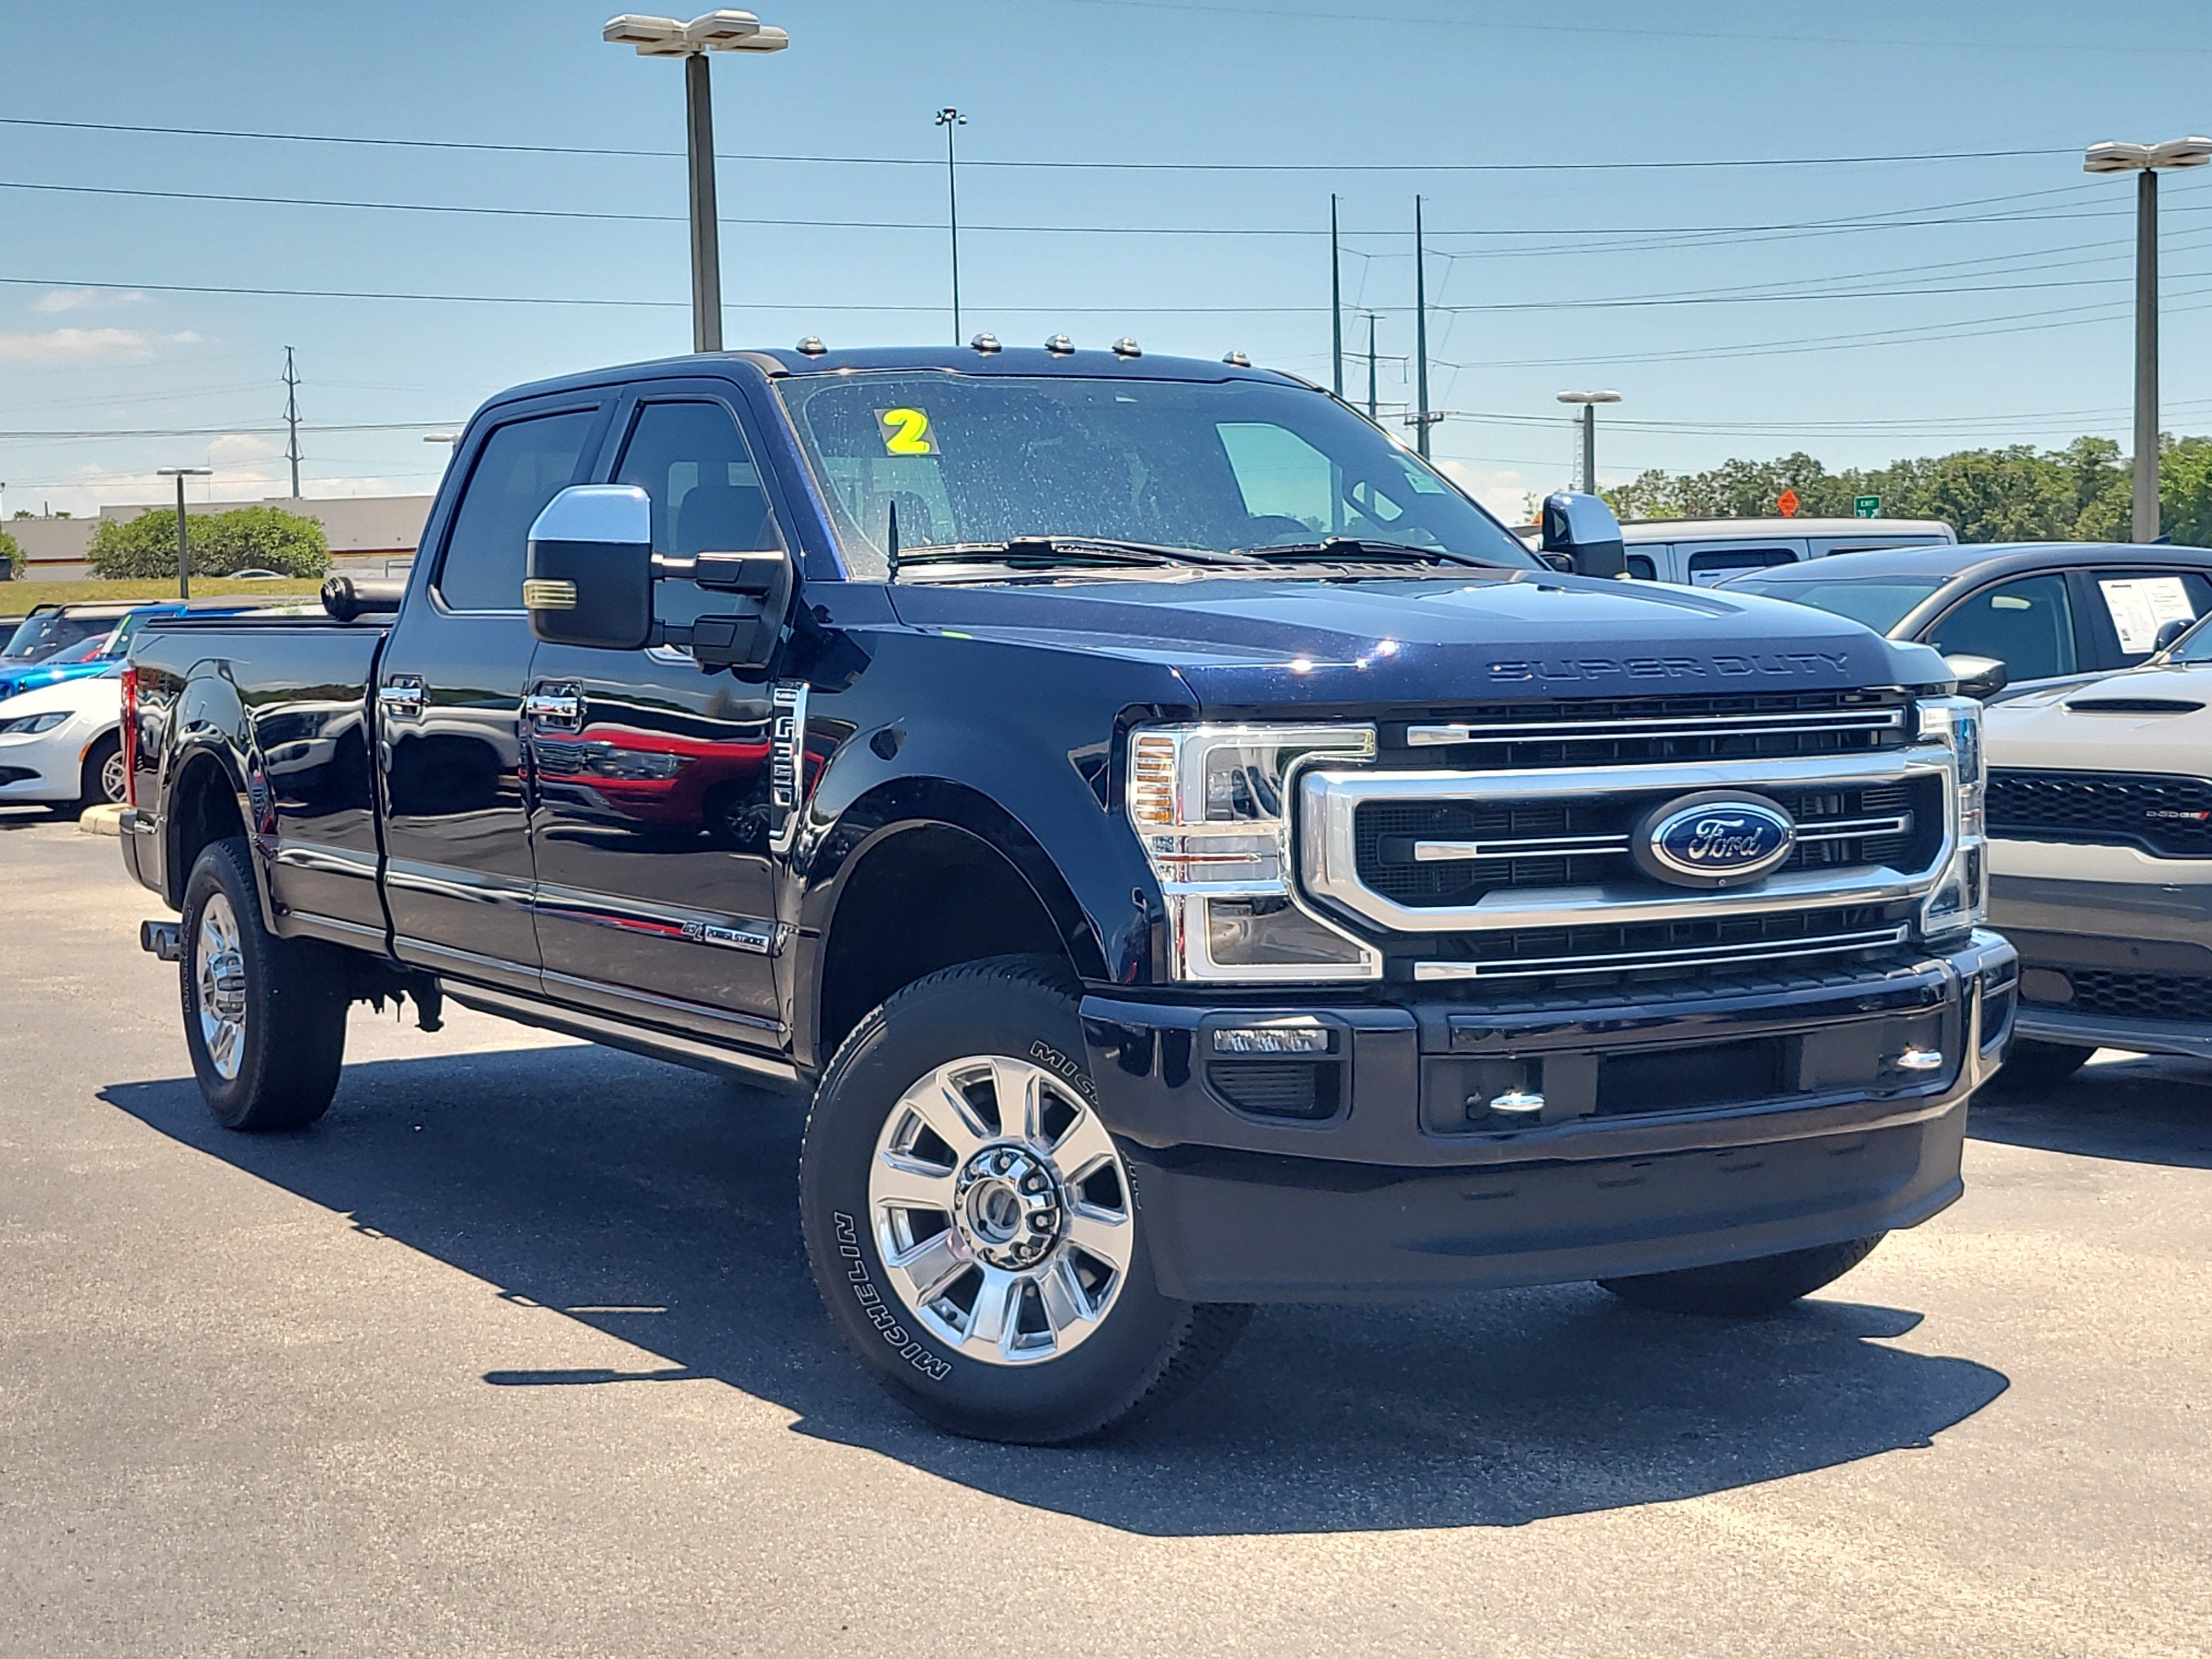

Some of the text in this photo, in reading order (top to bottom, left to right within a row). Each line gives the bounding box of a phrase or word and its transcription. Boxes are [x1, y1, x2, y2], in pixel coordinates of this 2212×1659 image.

[883, 409, 930, 454] 2
[1485, 653, 1849, 682] SUPER DUTY
[1688, 819, 1763, 860] Ford
[834, 1211, 952, 1381] MICHELIN
